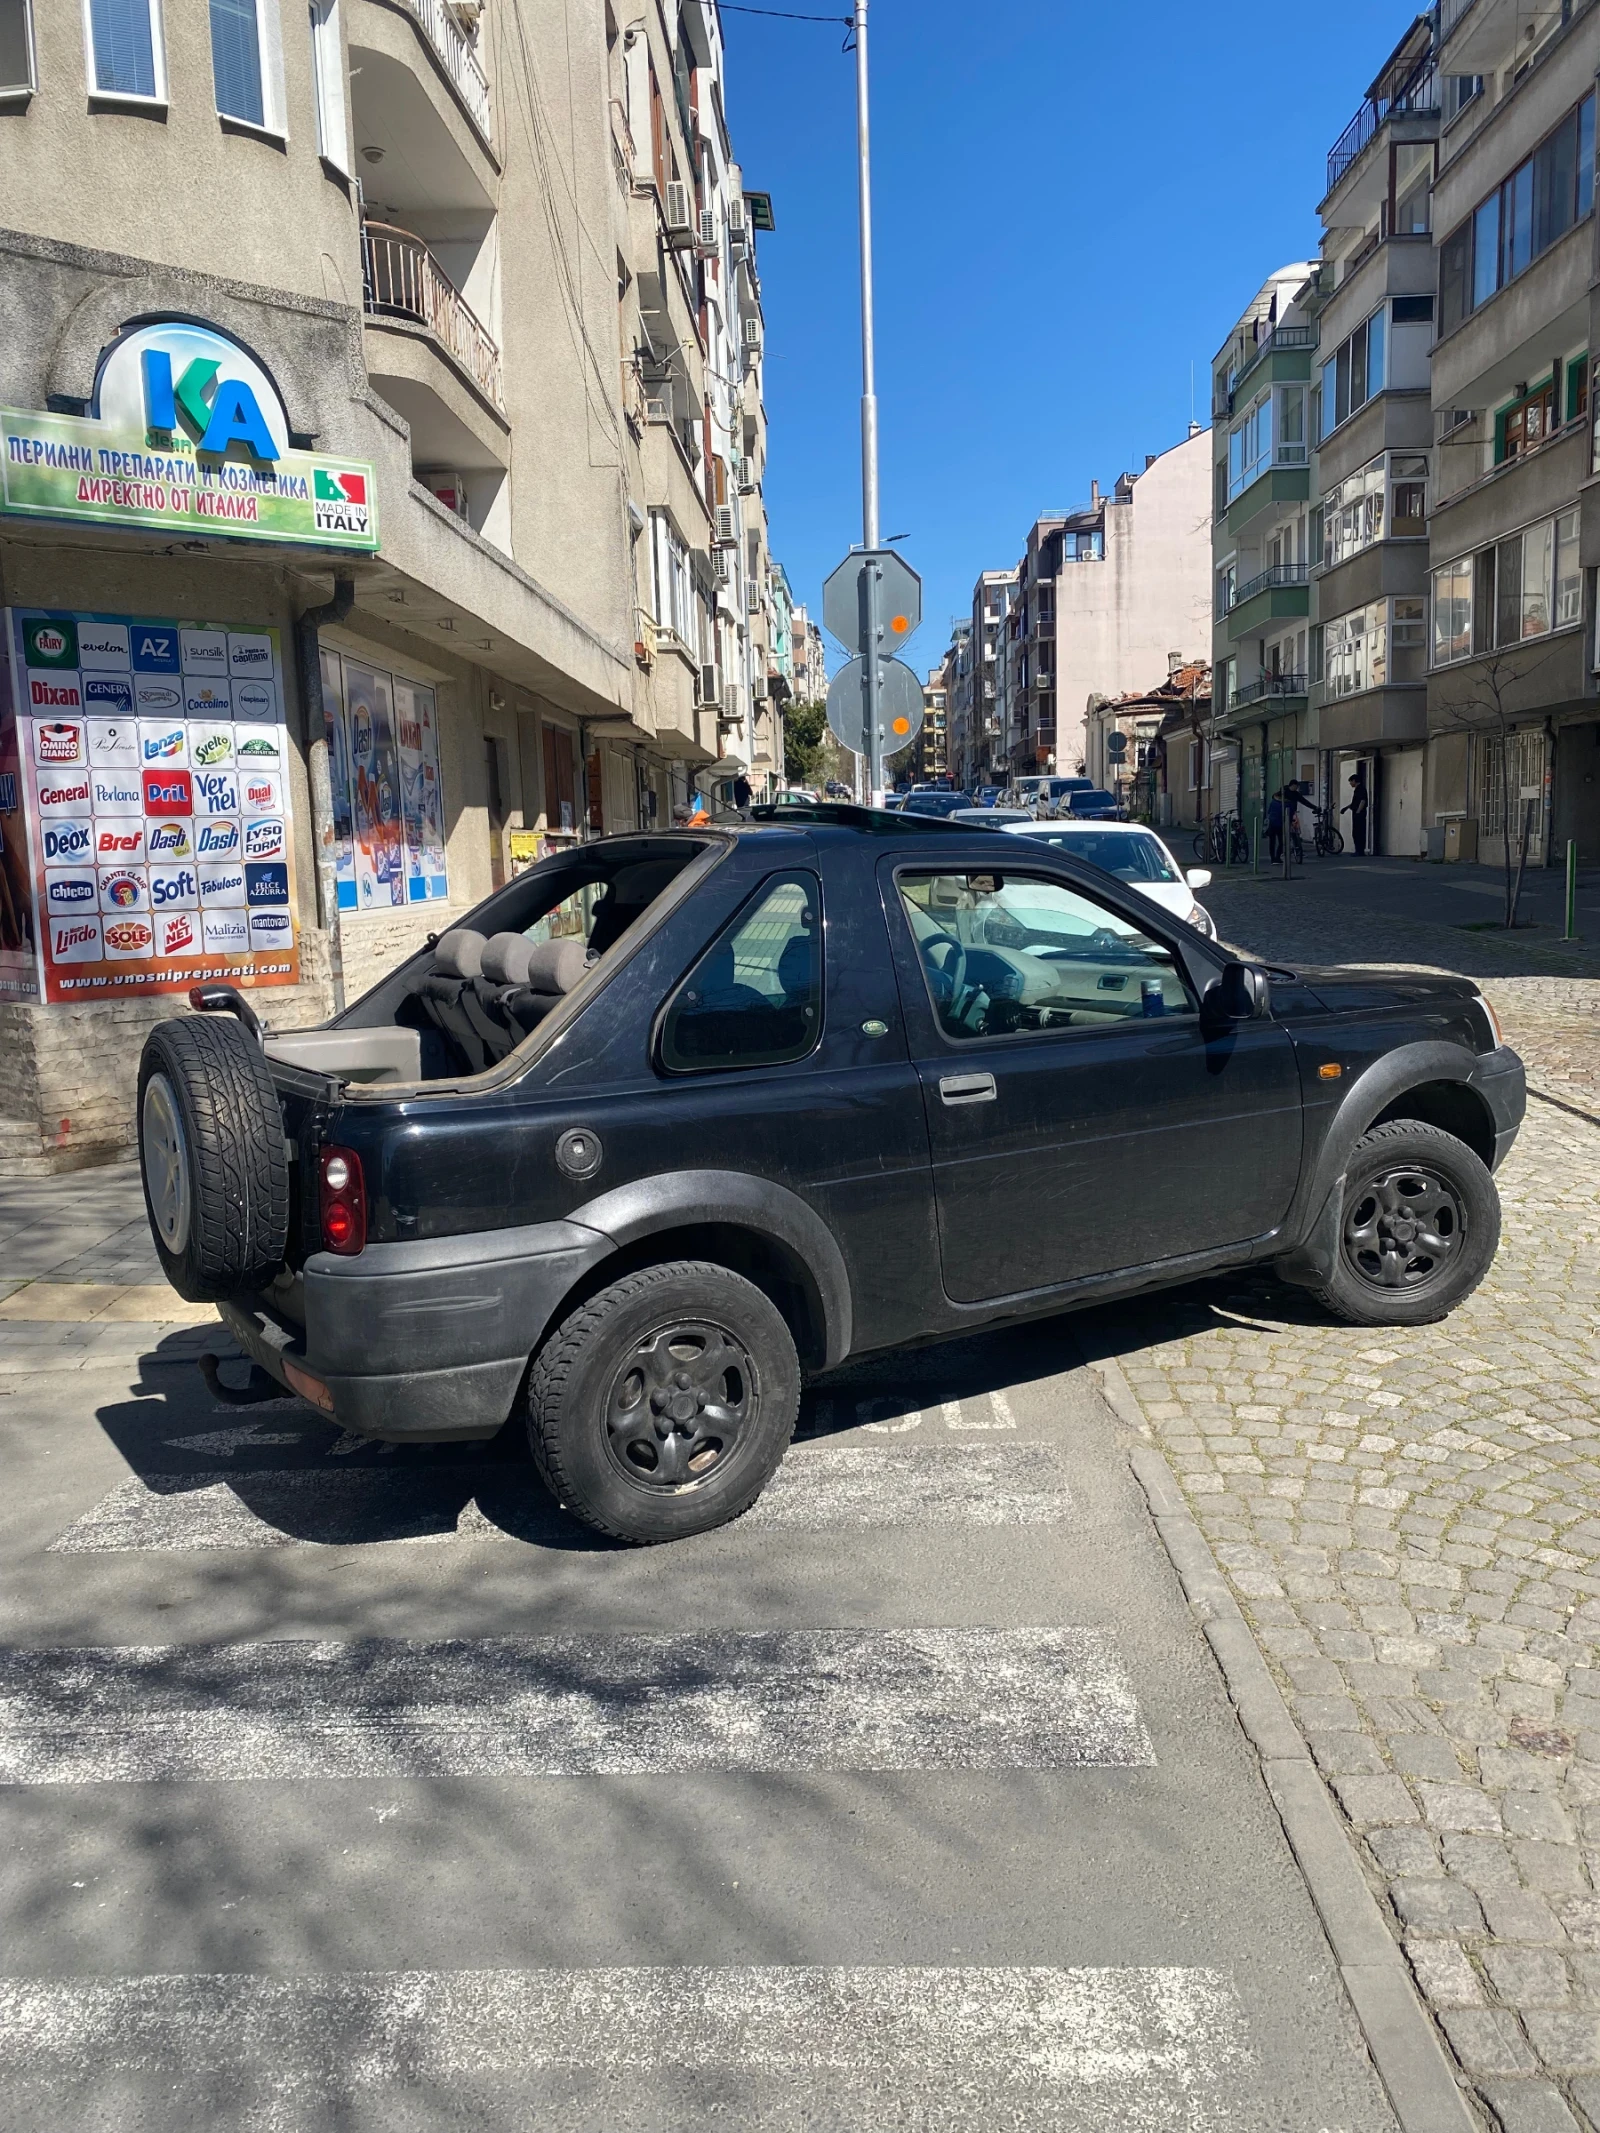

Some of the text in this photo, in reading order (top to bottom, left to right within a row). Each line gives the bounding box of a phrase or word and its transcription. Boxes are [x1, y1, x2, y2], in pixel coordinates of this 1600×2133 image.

[144, 432, 192, 455] clean
[8, 436, 309, 500] ПЕРИЛНИ ПРЕПАРАТИ И КОЗМЕТИКА
[77, 476, 259, 522] ДИРЕКТНО ОТ ИТАЛИЯ
[315, 501, 367, 517] MADE IN
[316, 513, 369, 533] ITALY
[39, 637, 63, 650] FAIRY
[80, 641, 128, 653] evelon
[140, 638, 171, 658] AZ
[190, 647, 225, 657] sunsilk
[31, 681, 80, 706] Dixan
[88, 683, 129, 695] GENERA
[188, 698, 229, 711] Coccolino
[353, 714, 372, 754] Dash
[41, 741, 78, 750] OMINO
[41, 749, 77, 758] BIANCO
[195, 735, 228, 766] Svelto
[40, 782, 89, 805] General
[95, 785, 140, 802] Perlana
[248, 784, 271, 801] Dual
[44, 828, 90, 858] Deox
[98, 831, 143, 851] Bref
[149, 828, 186, 850] Dash
[197, 826, 239, 852] Dash
[246, 825, 282, 843] LYSO
[246, 835, 282, 853] FORM
[100, 870, 147, 891] CHANTE CLAIR
[152, 871, 196, 904] Soft
[201, 876, 242, 895] Fabuloso
[255, 881, 280, 889] FELCE
[52, 884, 92, 899] chicco
[167, 915, 187, 932] WC
[205, 923, 246, 936] Malizia
[252, 915, 289, 928] mantovani
[56, 924, 97, 955] Lindo
[110, 930, 147, 944] SOLE
[166, 924, 190, 945] NET
